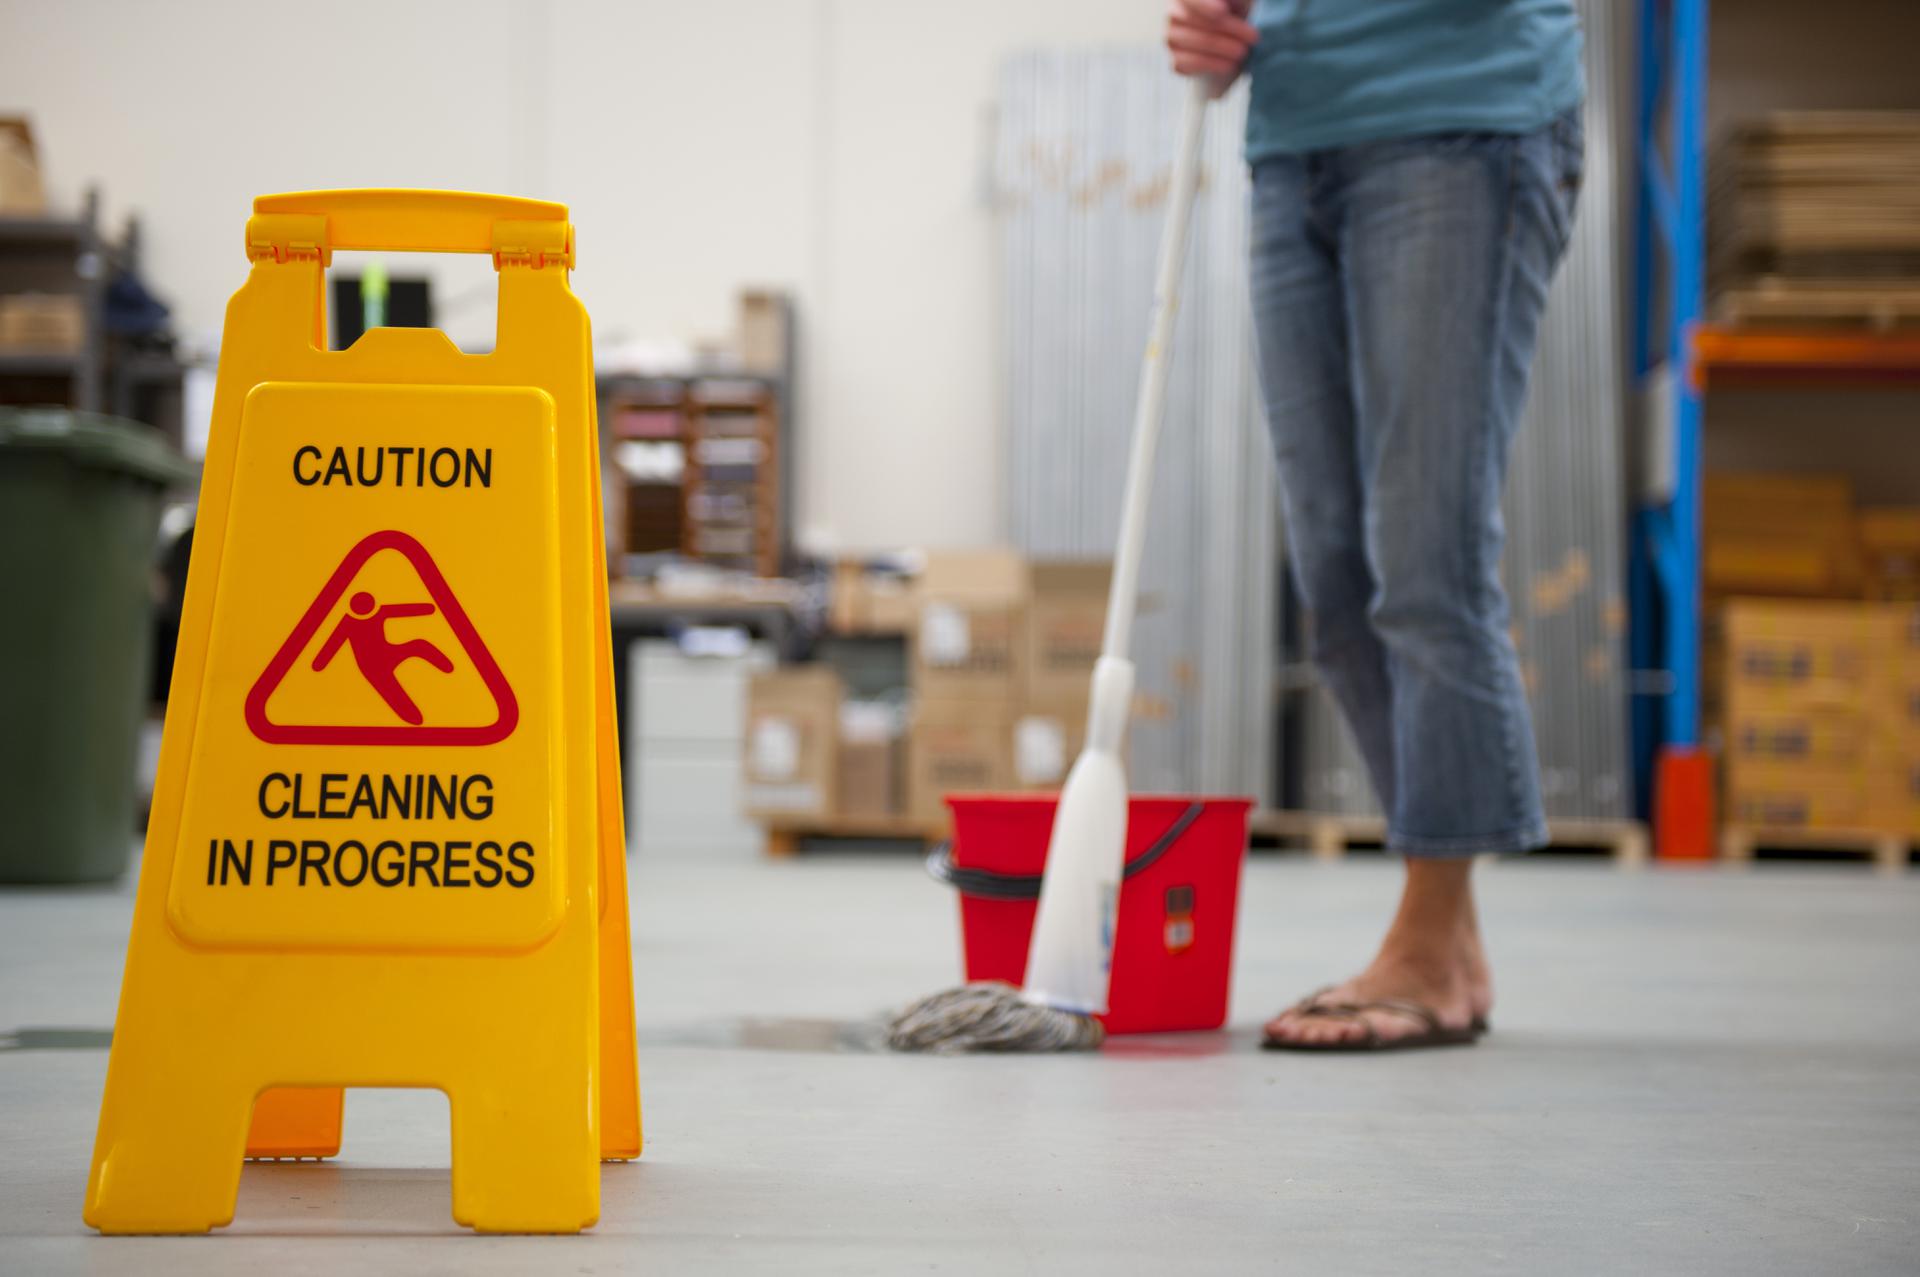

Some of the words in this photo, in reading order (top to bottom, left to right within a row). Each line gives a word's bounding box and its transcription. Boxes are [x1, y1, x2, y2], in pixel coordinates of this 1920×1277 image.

[292, 445, 493, 488] CAUTION
[258, 772, 494, 821] CLEANING
[206, 839, 254, 886] IN
[265, 839, 536, 889] PROGRESS
